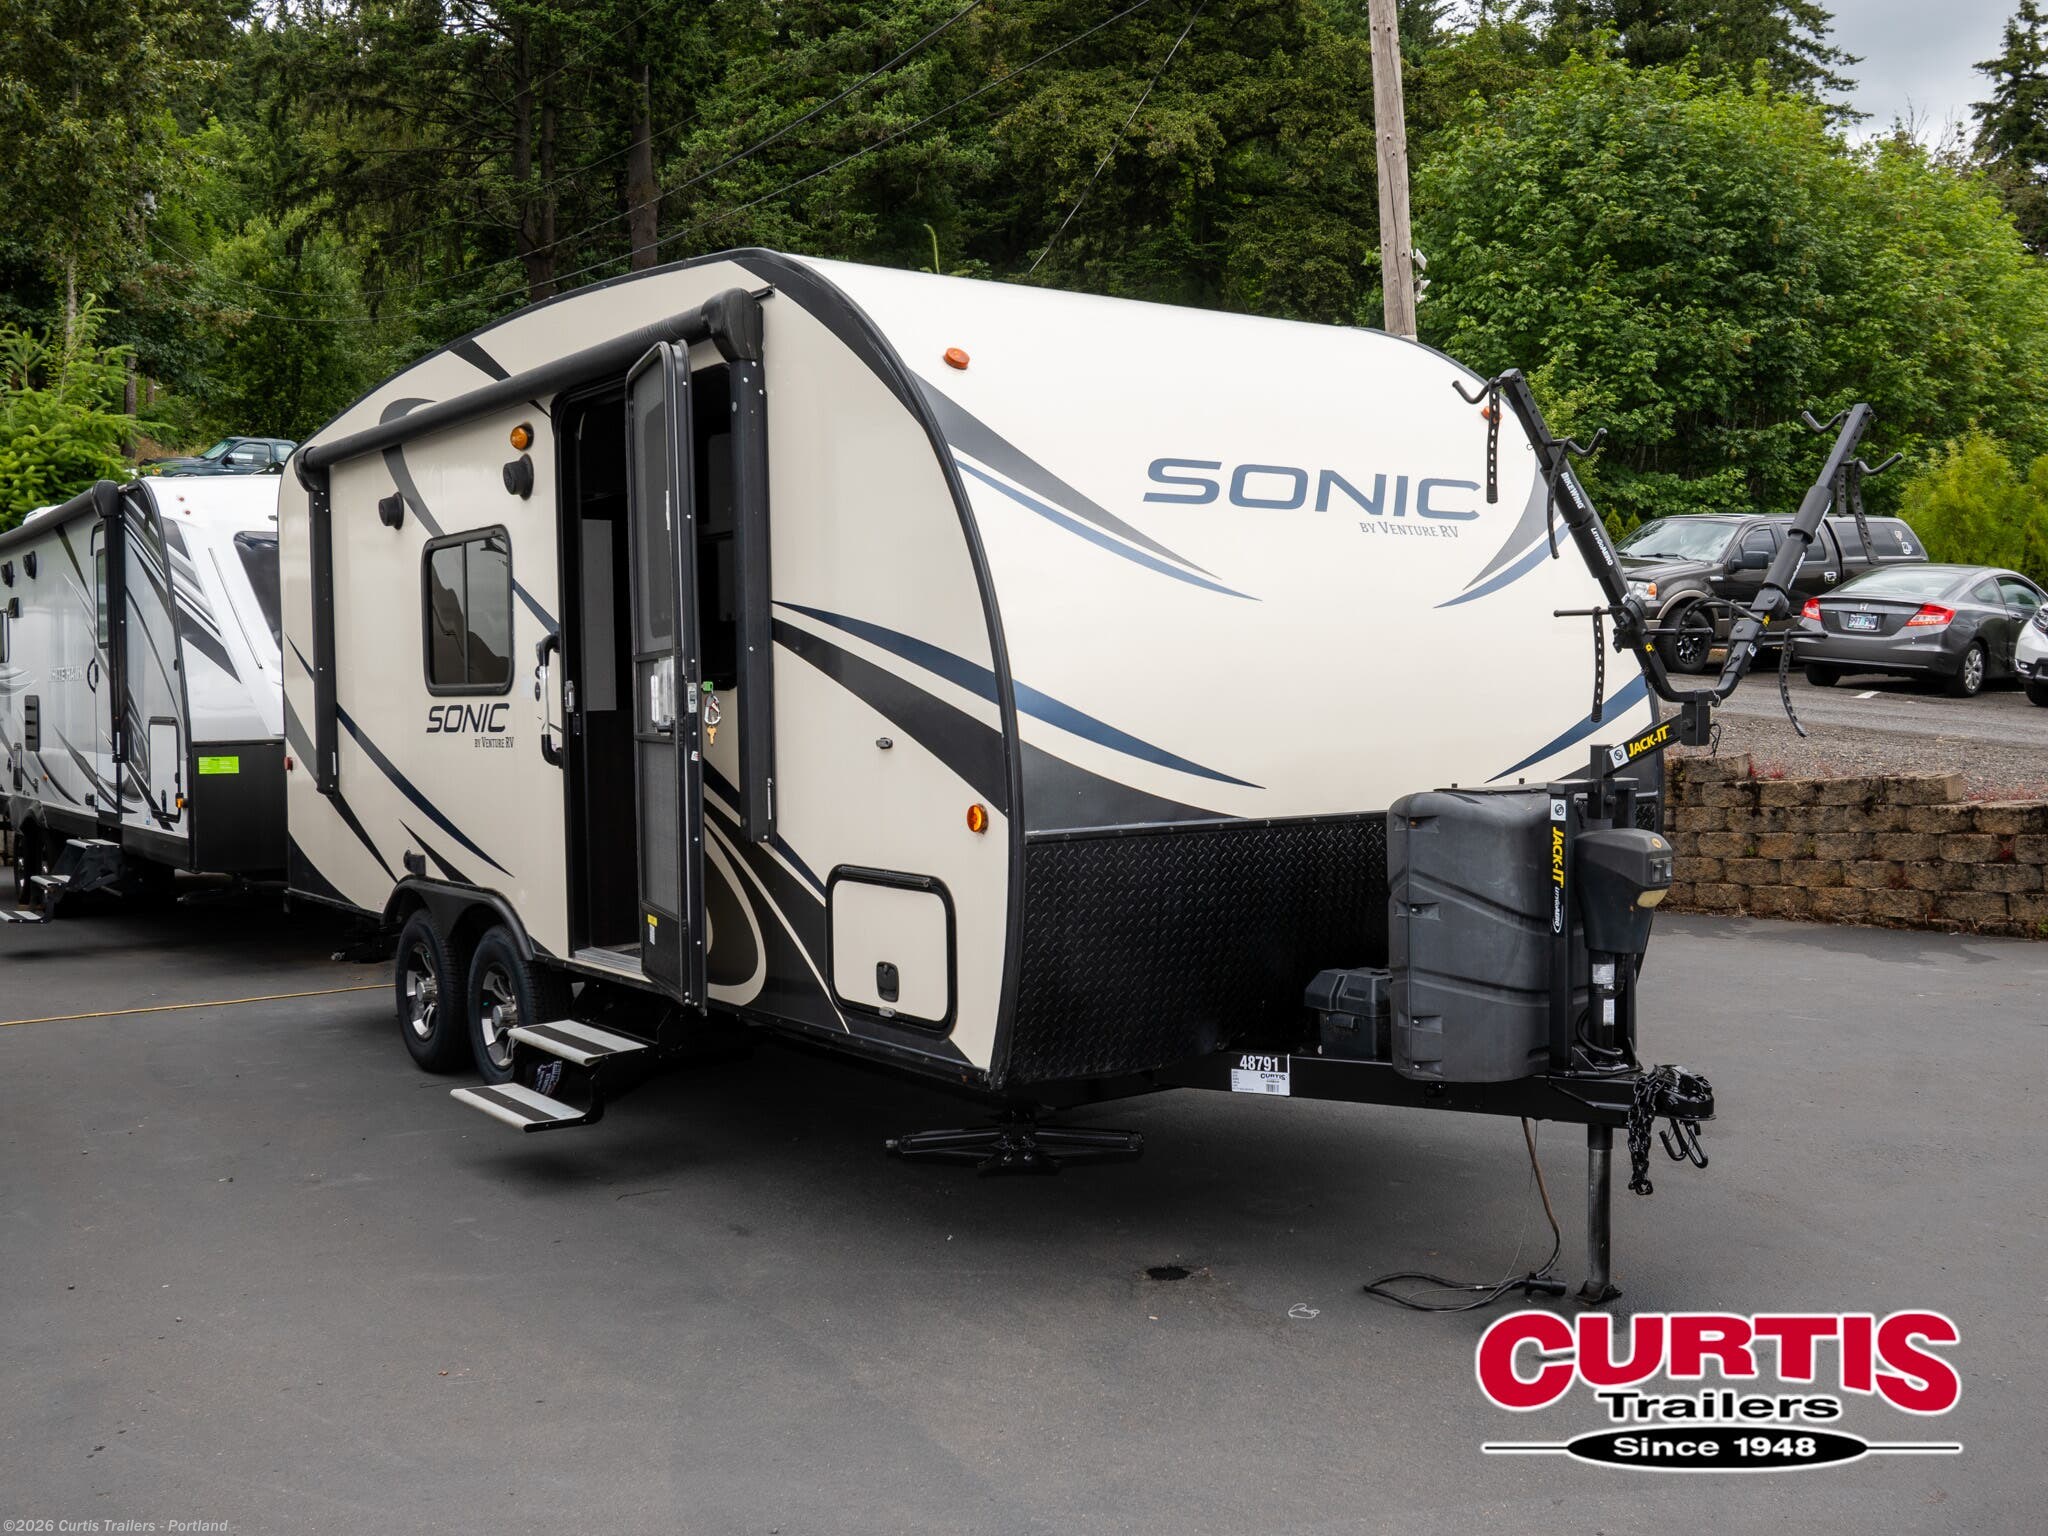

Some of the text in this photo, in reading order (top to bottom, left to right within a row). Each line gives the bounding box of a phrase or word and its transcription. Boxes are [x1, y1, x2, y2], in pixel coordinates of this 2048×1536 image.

[1143, 458, 1482, 520] SONIC
[1360, 521, 1459, 538] BY VENTURE RV
[426, 703, 510, 733] SONIC
[474, 737, 514, 748] BY VENTURE RV
[1628, 724, 1670, 758] JACK-IT
[1552, 826, 1564, 888] JACK-IT
[1240, 1055, 1279, 1072] 48791
[1260, 1072, 1286, 1080] CURTIS
